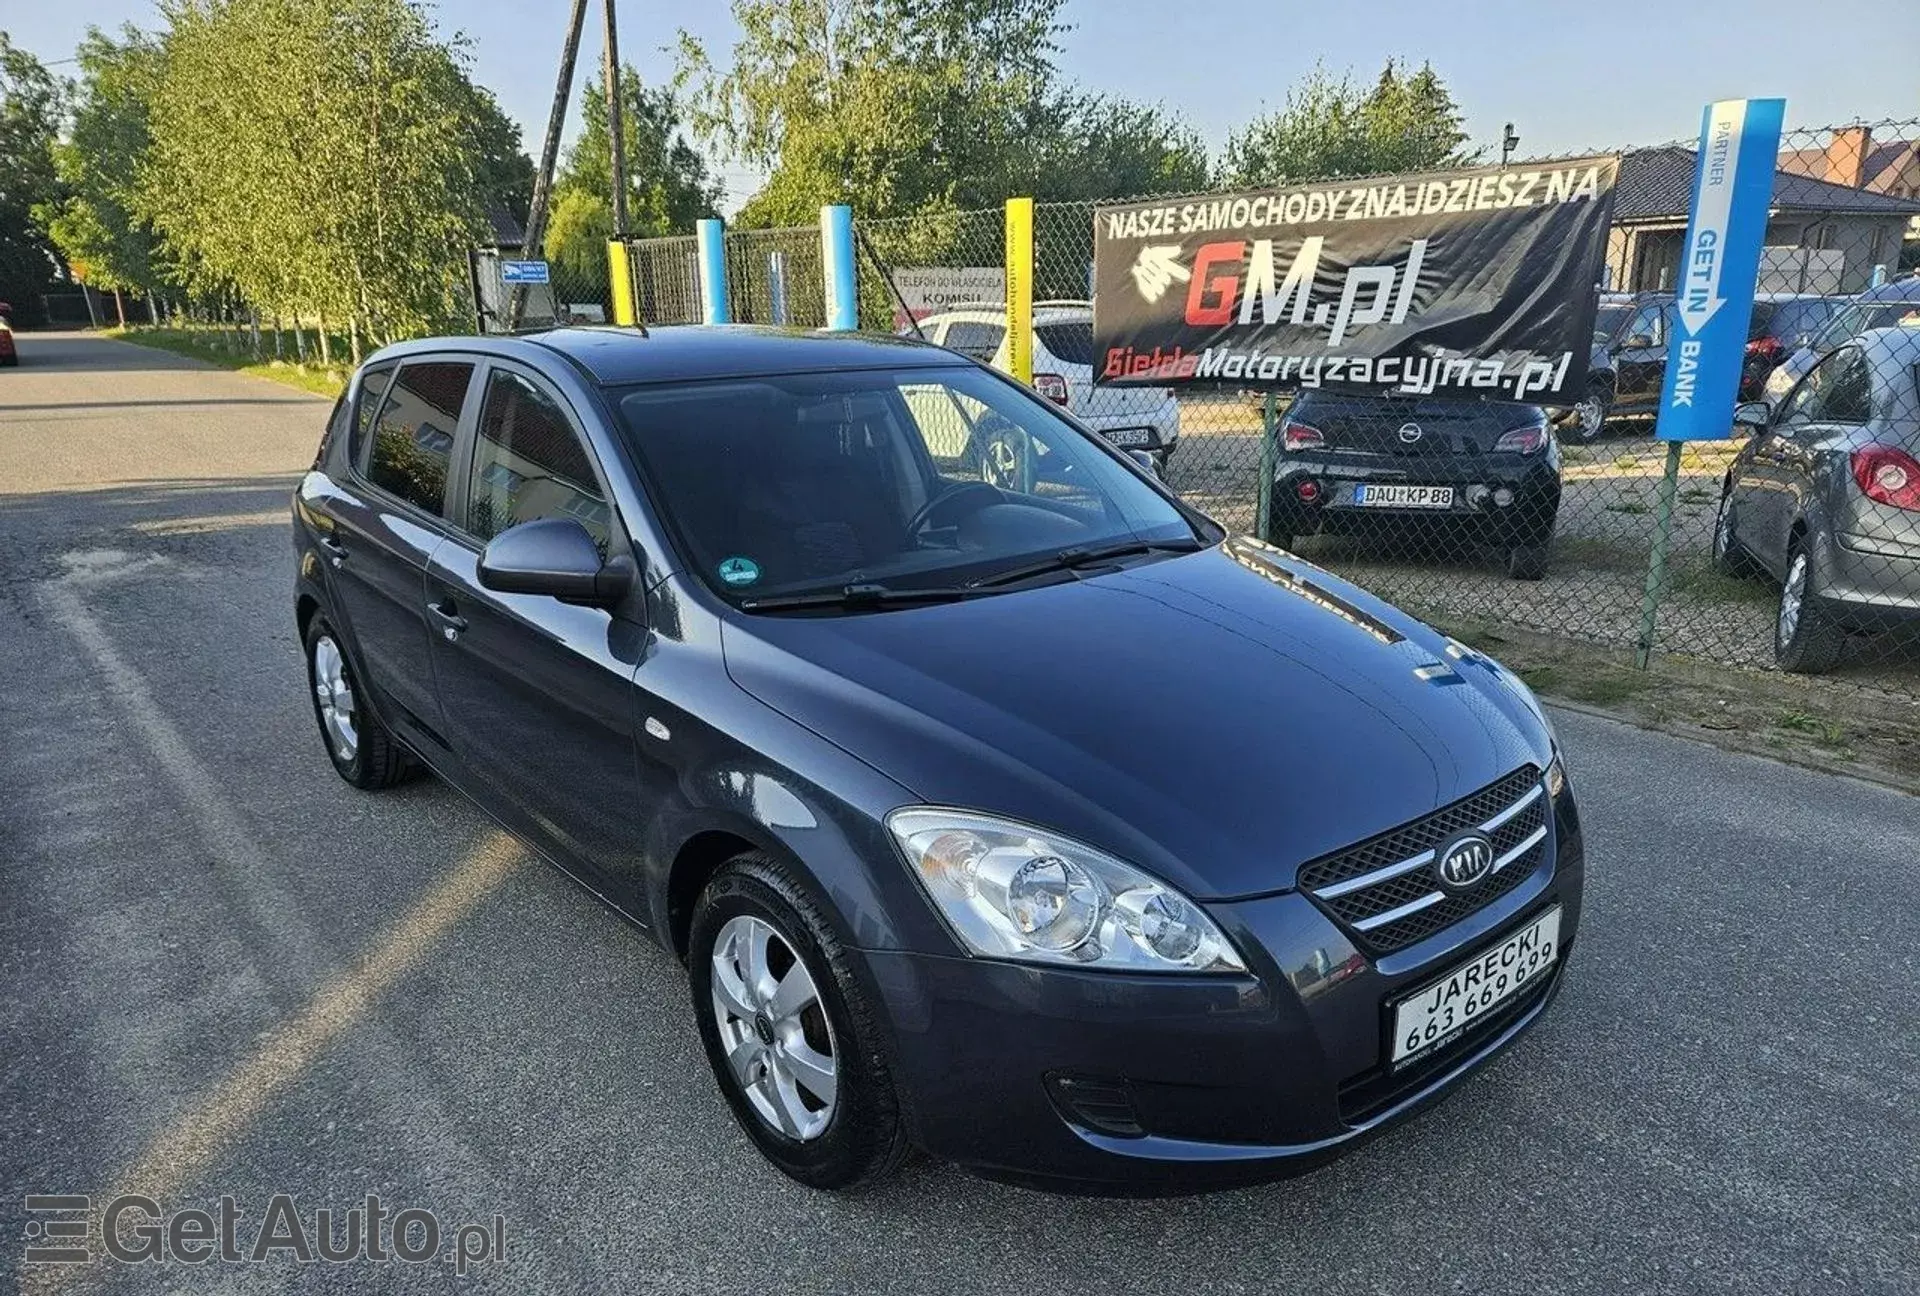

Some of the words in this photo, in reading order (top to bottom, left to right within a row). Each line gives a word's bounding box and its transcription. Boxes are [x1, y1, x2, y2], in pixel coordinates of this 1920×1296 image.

[1708, 122, 1731, 186] PARTNER
[1108, 206, 1177, 240] NASZE
[1179, 191, 1346, 234] SAMOCHODY
[1345, 171, 1541, 221] ZNAJDZIESZ
[1544, 167, 1600, 204] NA
[1693, 230, 1717, 281] GET
[1185, 236, 1427, 346] GM.pl
[1687, 288, 1709, 312] IN
[1104, 346, 1573, 400] GiełdaMotoryzacyjna.pl
[1671, 340, 1701, 408] BANK
[1365, 487, 1397, 502] DAU
[1449, 845, 1487, 881] KIA
[1405, 1007, 1454, 1051] 663
[1464, 973, 1508, 1016] 669
[1515, 941, 1553, 983] 699
[1427, 925, 1541, 1014] JARECKI
